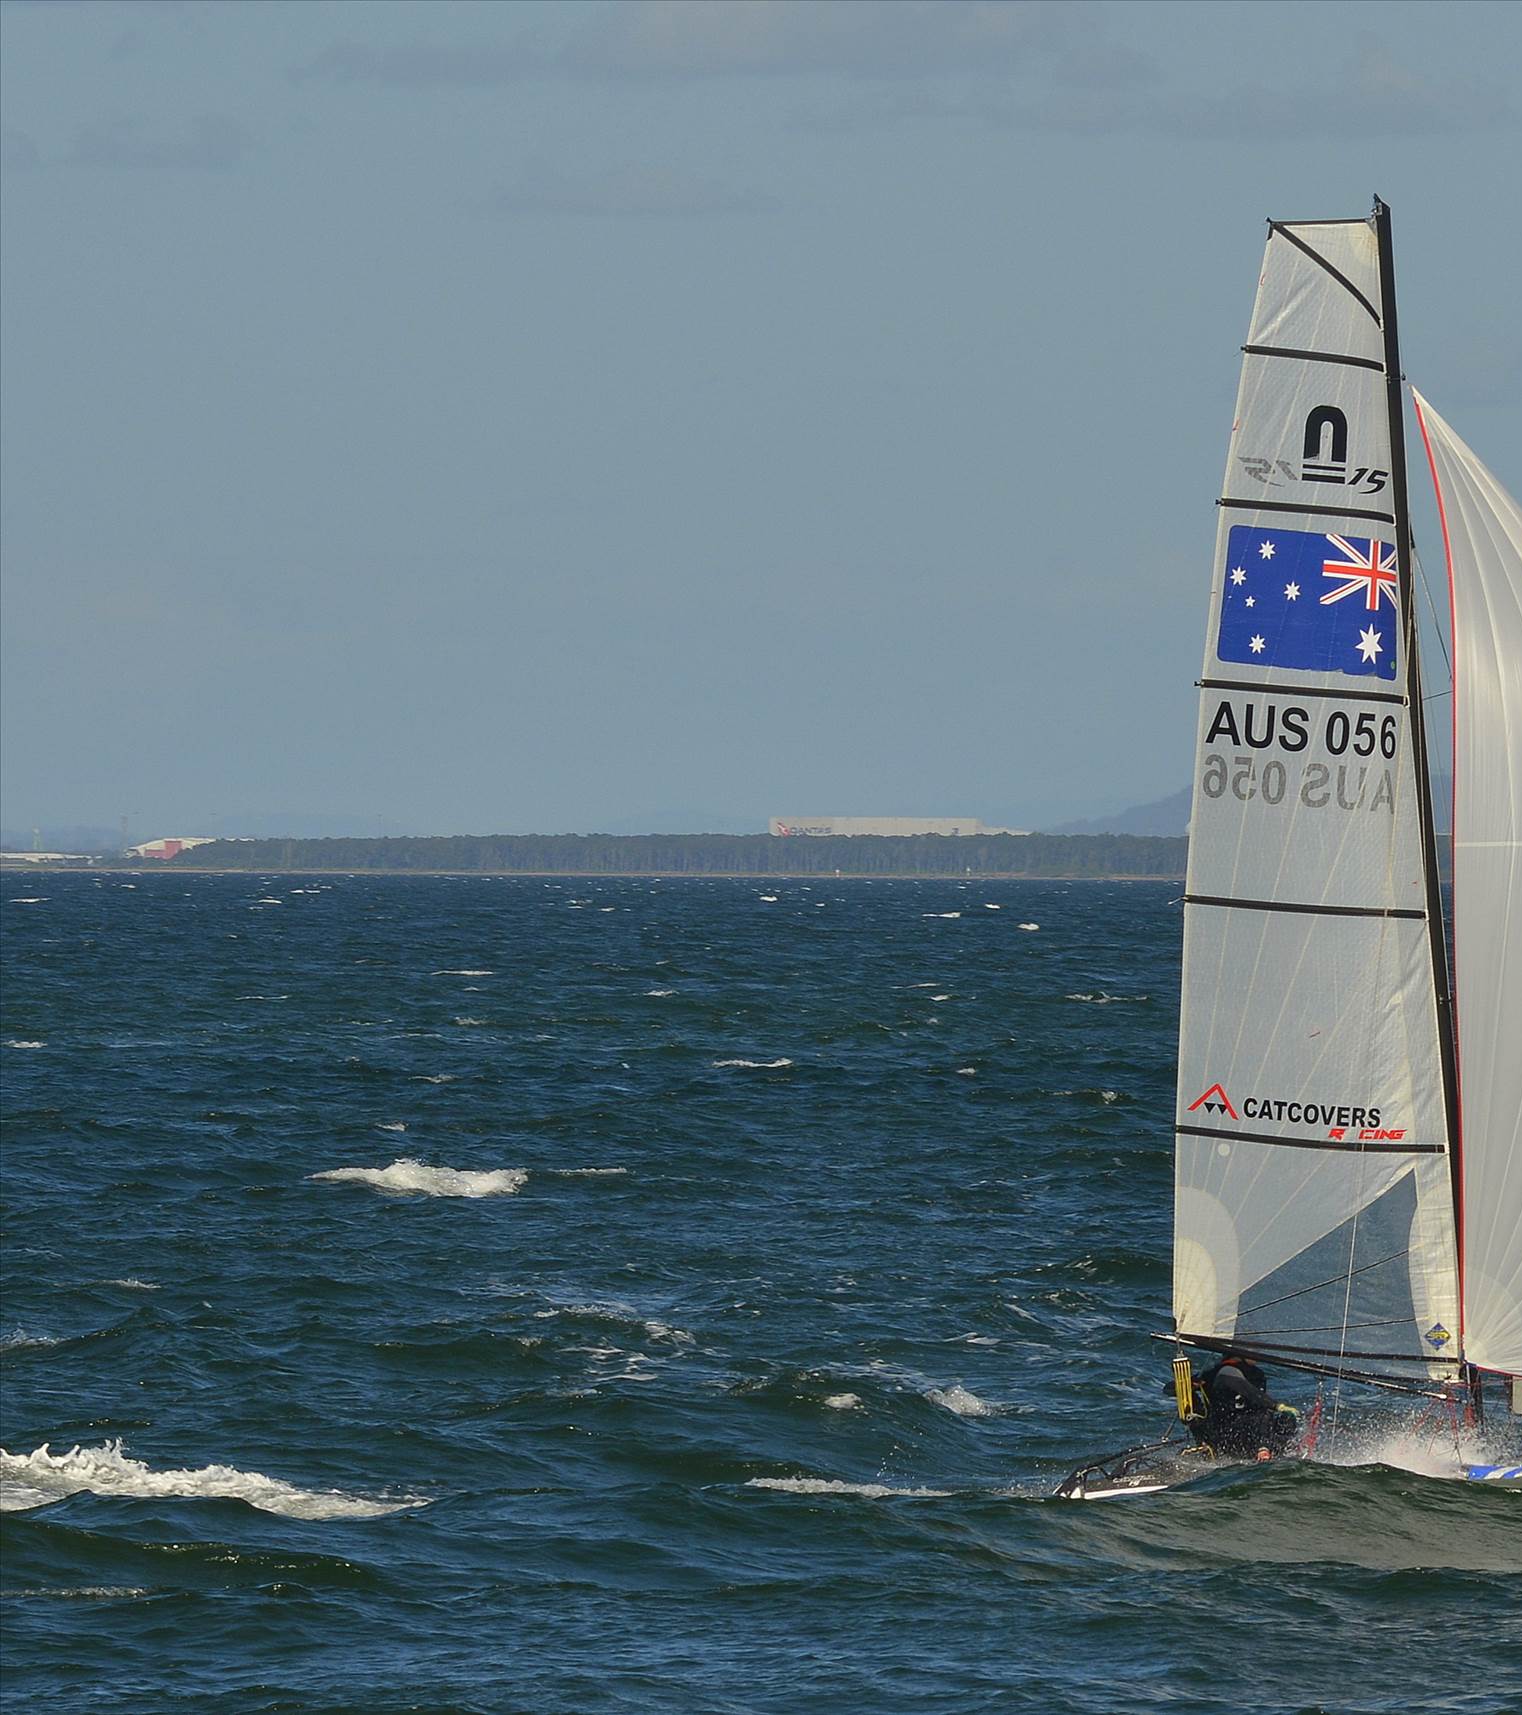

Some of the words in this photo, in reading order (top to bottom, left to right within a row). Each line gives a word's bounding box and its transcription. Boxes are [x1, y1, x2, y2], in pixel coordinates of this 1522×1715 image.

[1347, 468, 1389, 494] 15
[1205, 701, 1310, 752] AUS
[1325, 711, 1397, 759] 056
[1243, 1097, 1381, 1128] CATCOVERS
